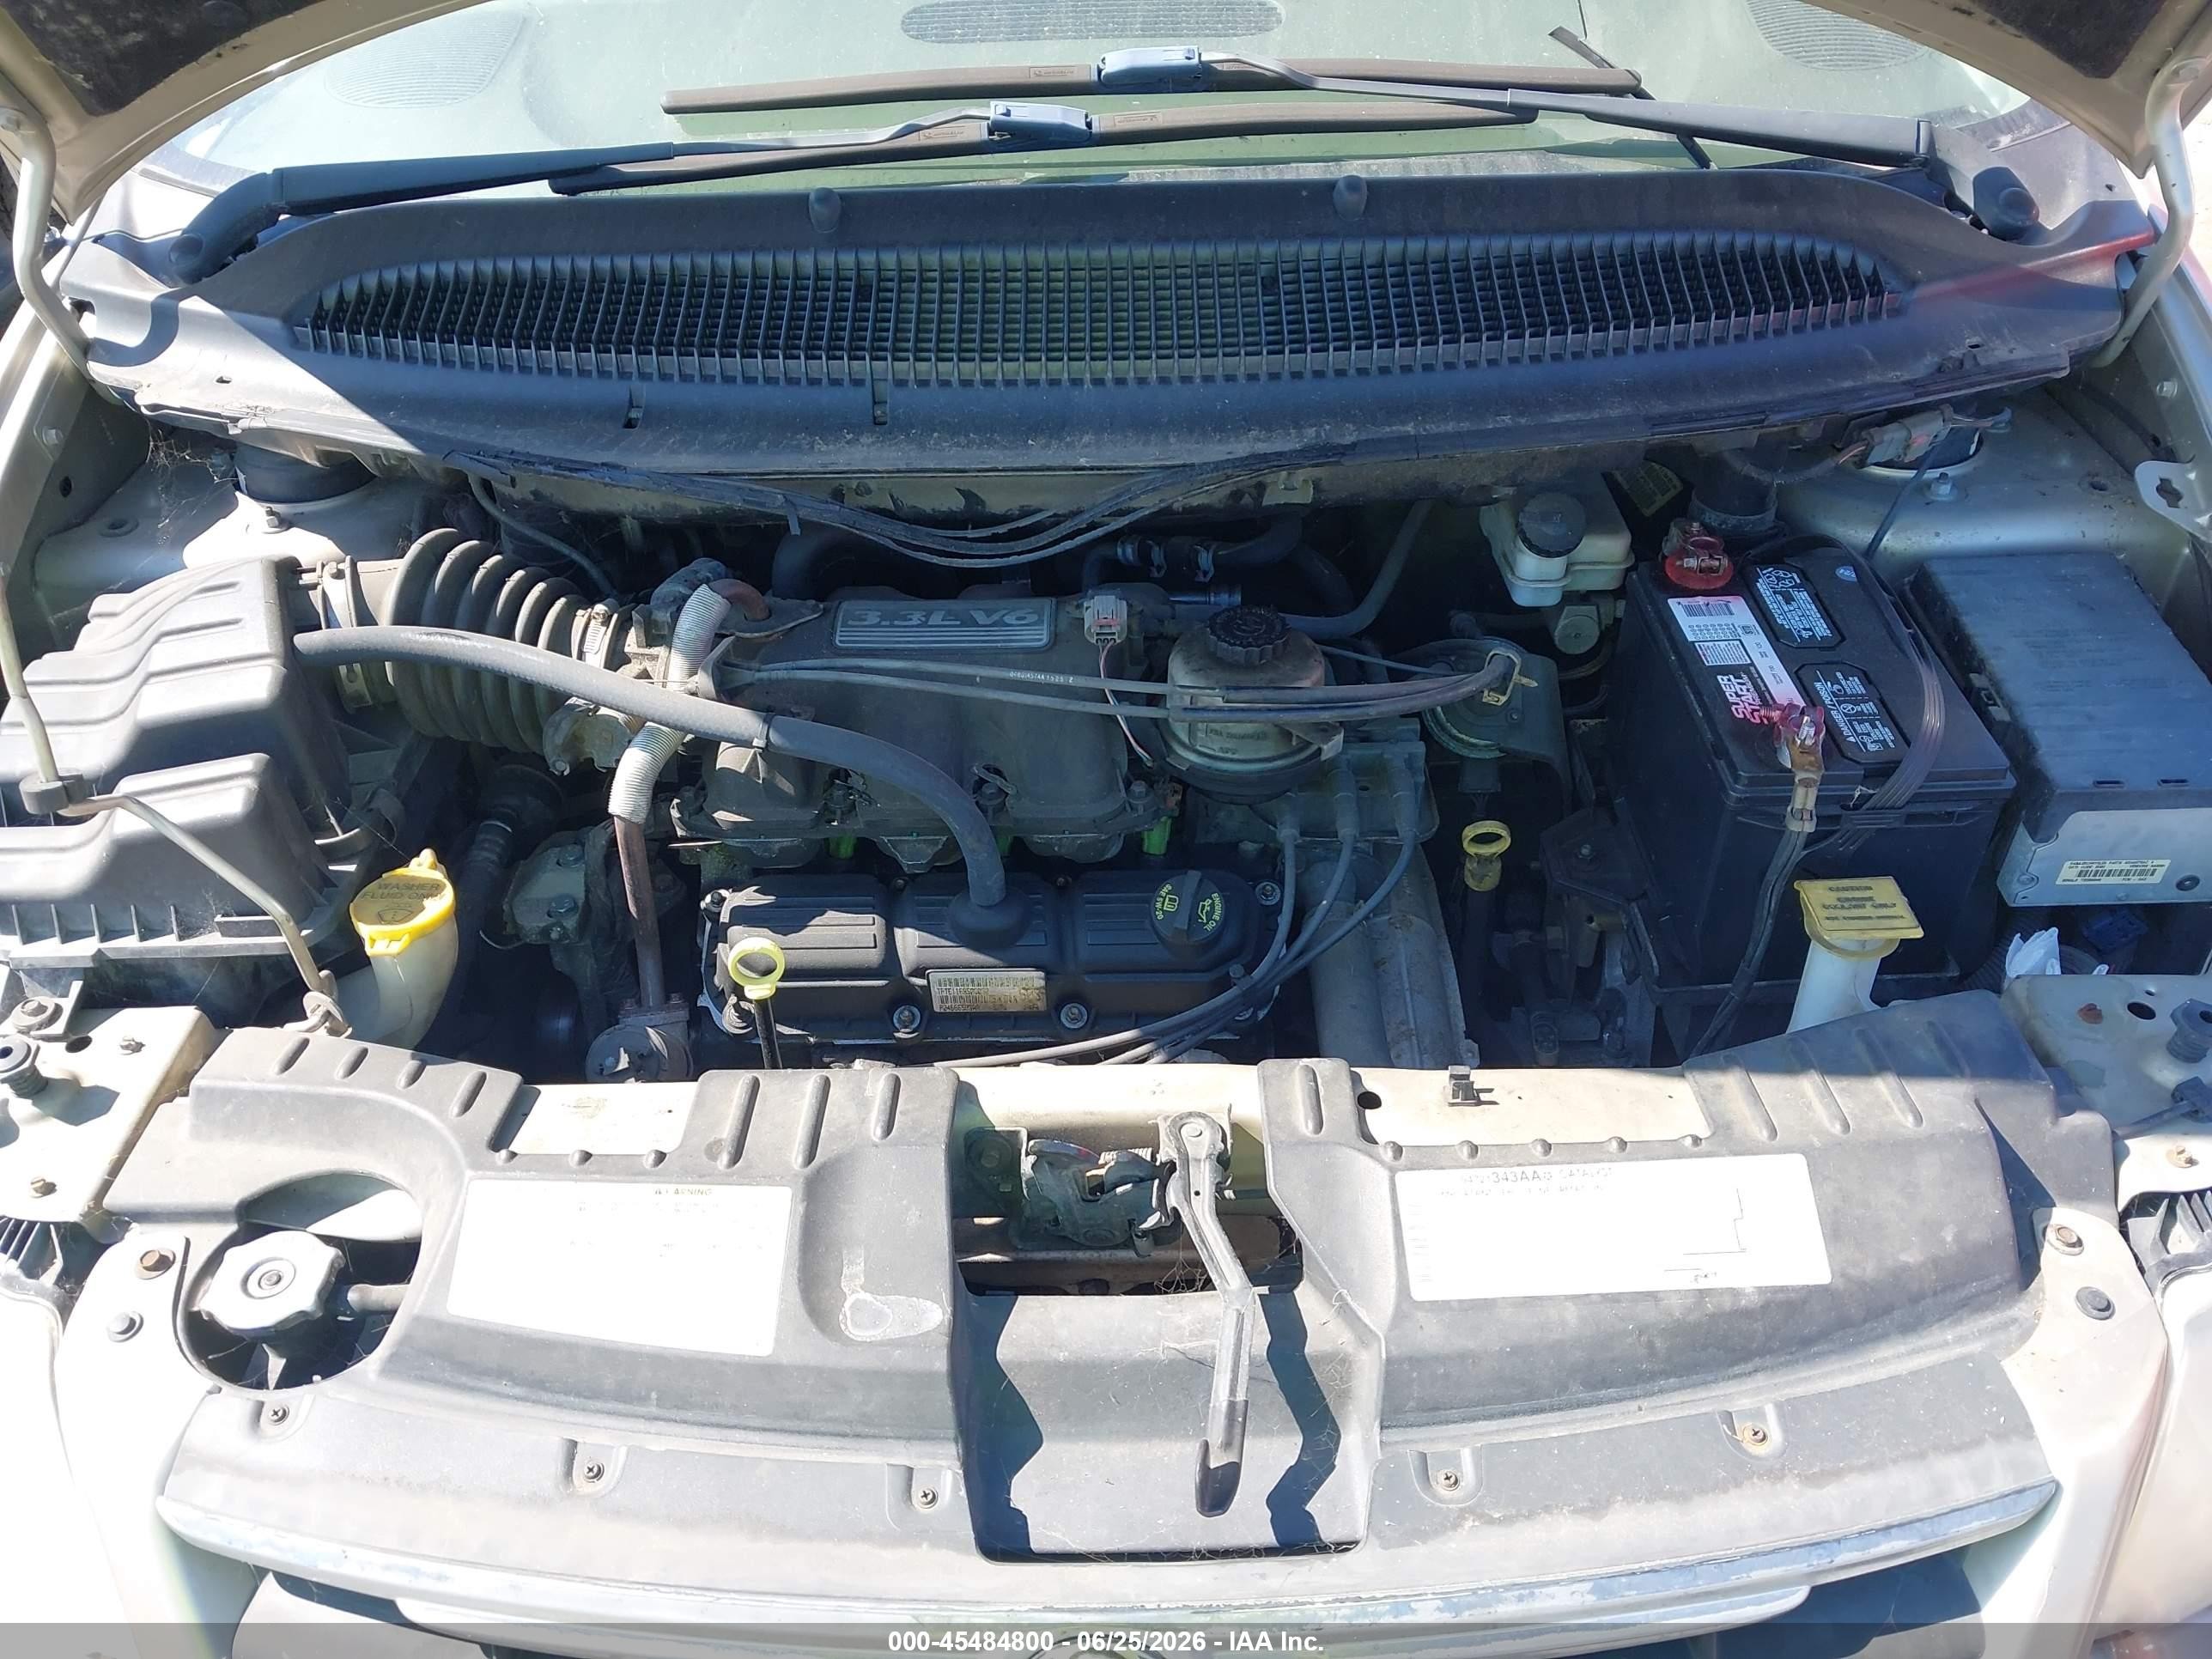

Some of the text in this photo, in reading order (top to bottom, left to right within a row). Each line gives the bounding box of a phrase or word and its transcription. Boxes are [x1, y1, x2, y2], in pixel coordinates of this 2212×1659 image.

[847, 608, 1039, 626] 3.3L V6
[1717, 674, 1746, 719] SUPER
[1813, 682, 1834, 705] POISON
[1830, 710, 1853, 736] DANGER
[1159, 884, 1172, 896] SAE
[1203, 892, 1222, 932] ENGINE OIL
